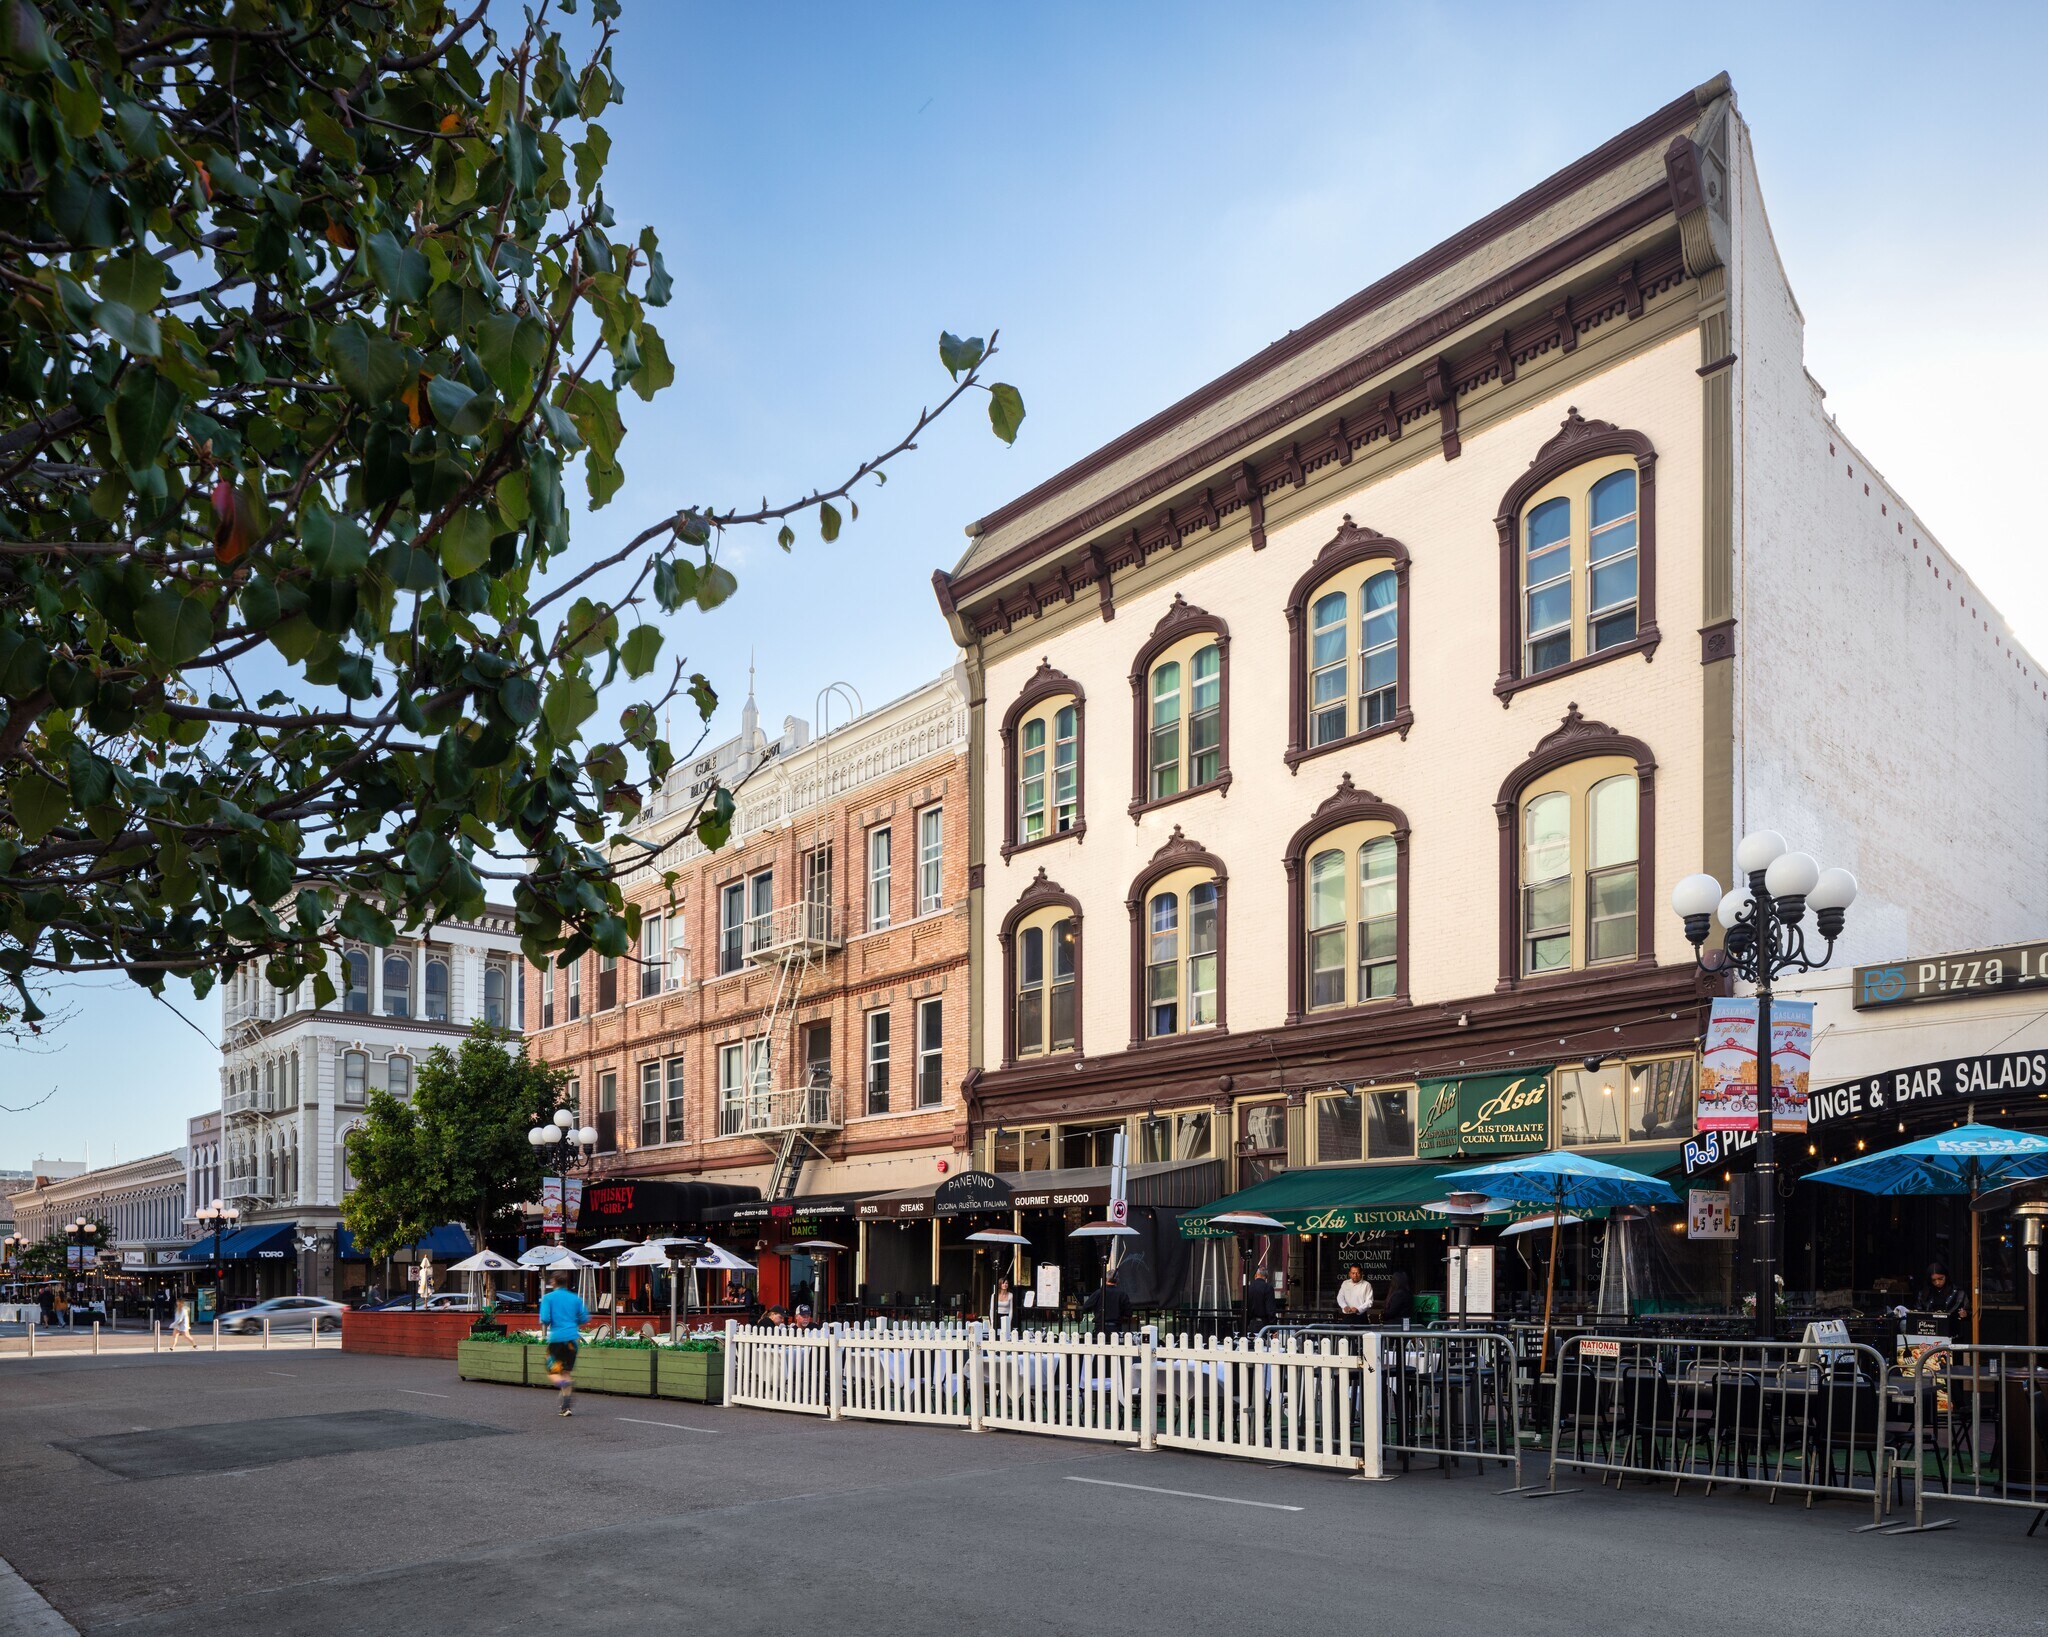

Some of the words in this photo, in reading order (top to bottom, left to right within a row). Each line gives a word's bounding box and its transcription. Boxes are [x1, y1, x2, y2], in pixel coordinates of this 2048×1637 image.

[694, 755, 717, 777] COLE
[1918, 958, 2003, 993] Pizza
[1418, 1083, 1457, 1139] Asti
[1460, 1078, 1546, 1132] Asti
[1722, 1131, 1758, 1156] PIZ
[1808, 1085, 1862, 1123] UNGE
[1869, 1080, 1884, 1107] &
[1896, 1068, 1943, 1101] BAR
[1955, 1055, 2047, 1093] SALADS
[1478, 1123, 1545, 1133] RISTORANTE
[1462, 1135, 1495, 1143] CUCINA
[1499, 1134, 1544, 1143] ITALIANA
[1937, 1137, 2047, 1150] KONA
[948, 1174, 995, 1192] PANEVINO
[589, 1186, 635, 1212] WHISKEY
[937, 1203, 957, 1211] CUCINA
[958, 1201, 982, 1210] RUSTICA
[983, 1199, 1008, 1208] ITALIANA
[1015, 1195, 1050, 1206] GOURMET
[1053, 1194, 1089, 1204] SEAFOOD
[603, 1202, 622, 1214] GIRL
[744, 1209, 756, 1217] dance
[796, 1207, 809, 1216] nightly
[860, 1205, 878, 1214] PASTA
[900, 1203, 924, 1212] STEAKS
[1297, 1208, 1348, 1232] Asti
[1354, 1209, 1447, 1224] RISTORANTE
[792, 1226, 818, 1236] DANCE
[1338, 1250, 1392, 1260] RISTORANTE
[1581, 1341, 1619, 1350] NATIONAL
